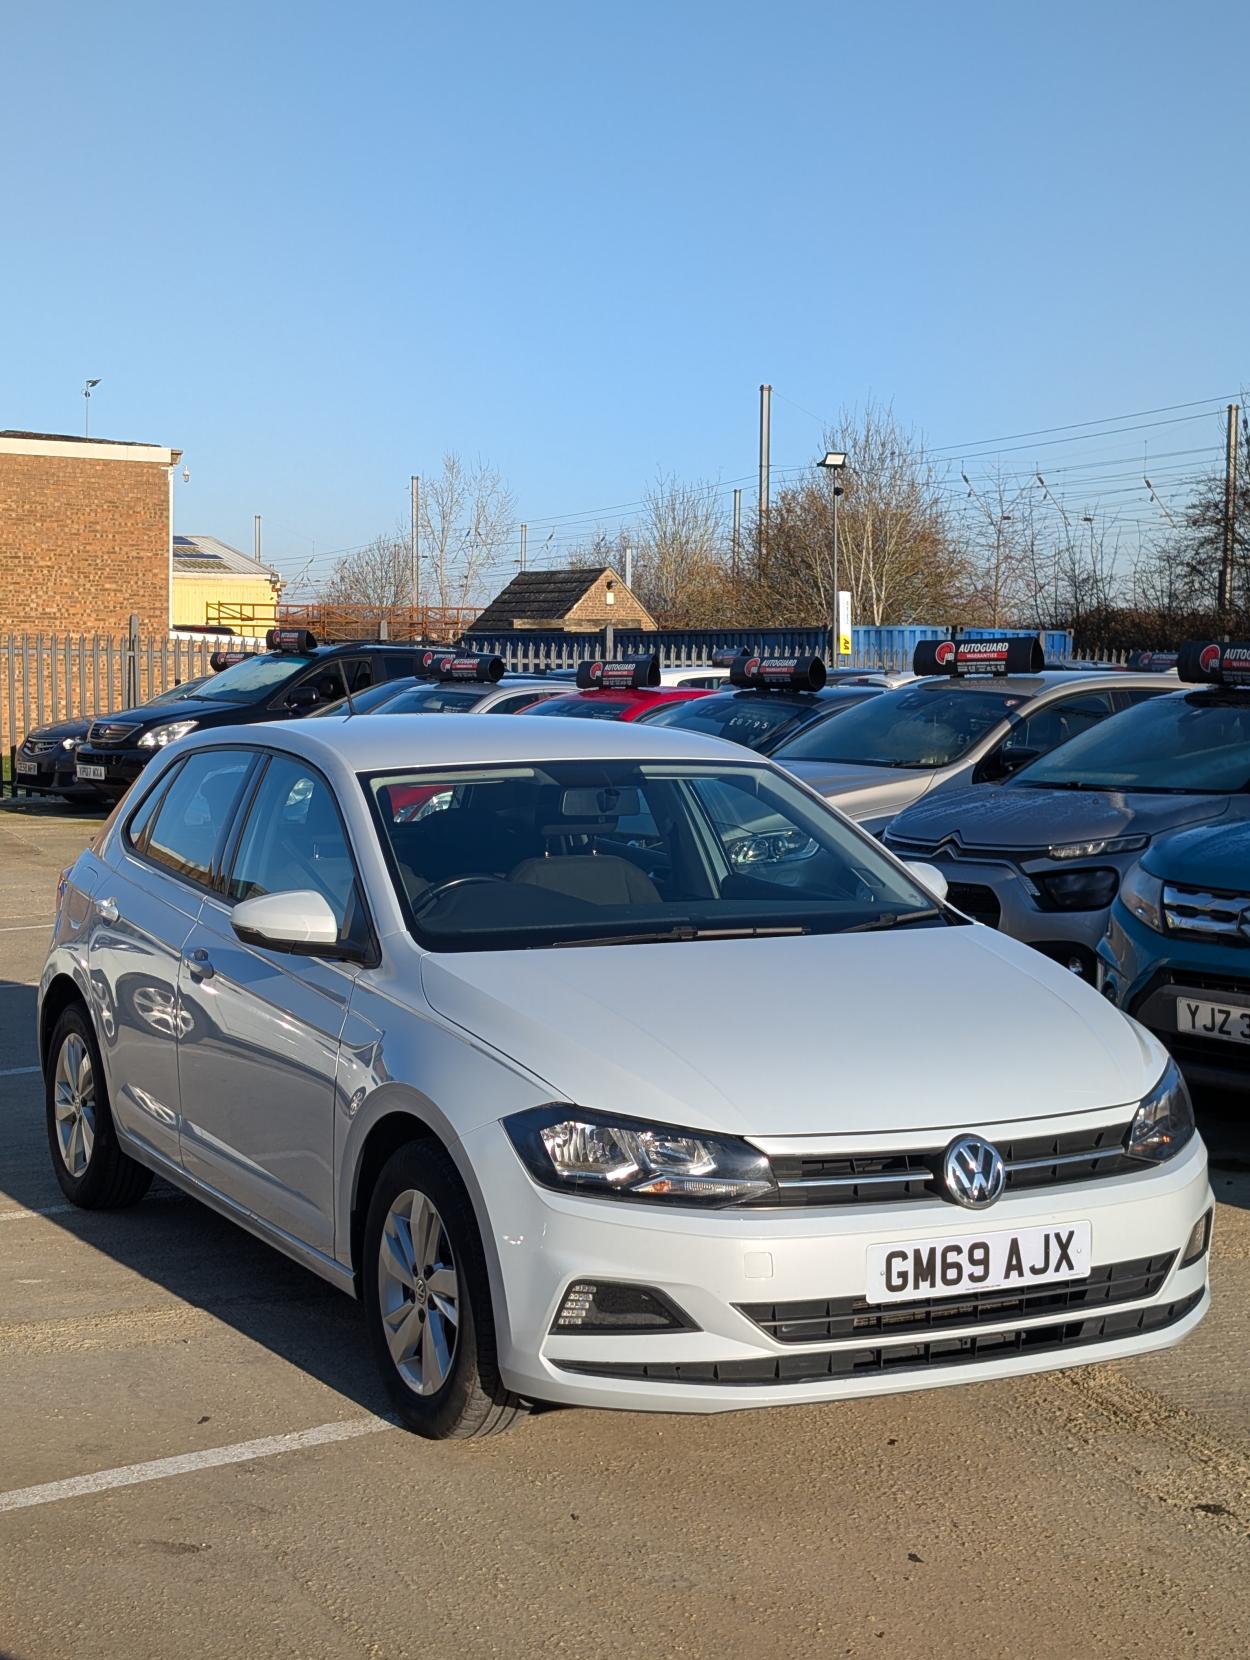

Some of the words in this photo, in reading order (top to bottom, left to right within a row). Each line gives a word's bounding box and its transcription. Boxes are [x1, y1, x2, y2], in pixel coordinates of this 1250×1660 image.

[958, 642, 1009, 653] AUTOGUARD
[604, 663, 636, 671] AUTOGUARD
[760, 659, 798, 667] AUTOGUARD
[1186, 1003, 1232, 1036] YJZ
[885, 1241, 990, 1292] GM69
[1003, 1230, 1075, 1280] AJX
